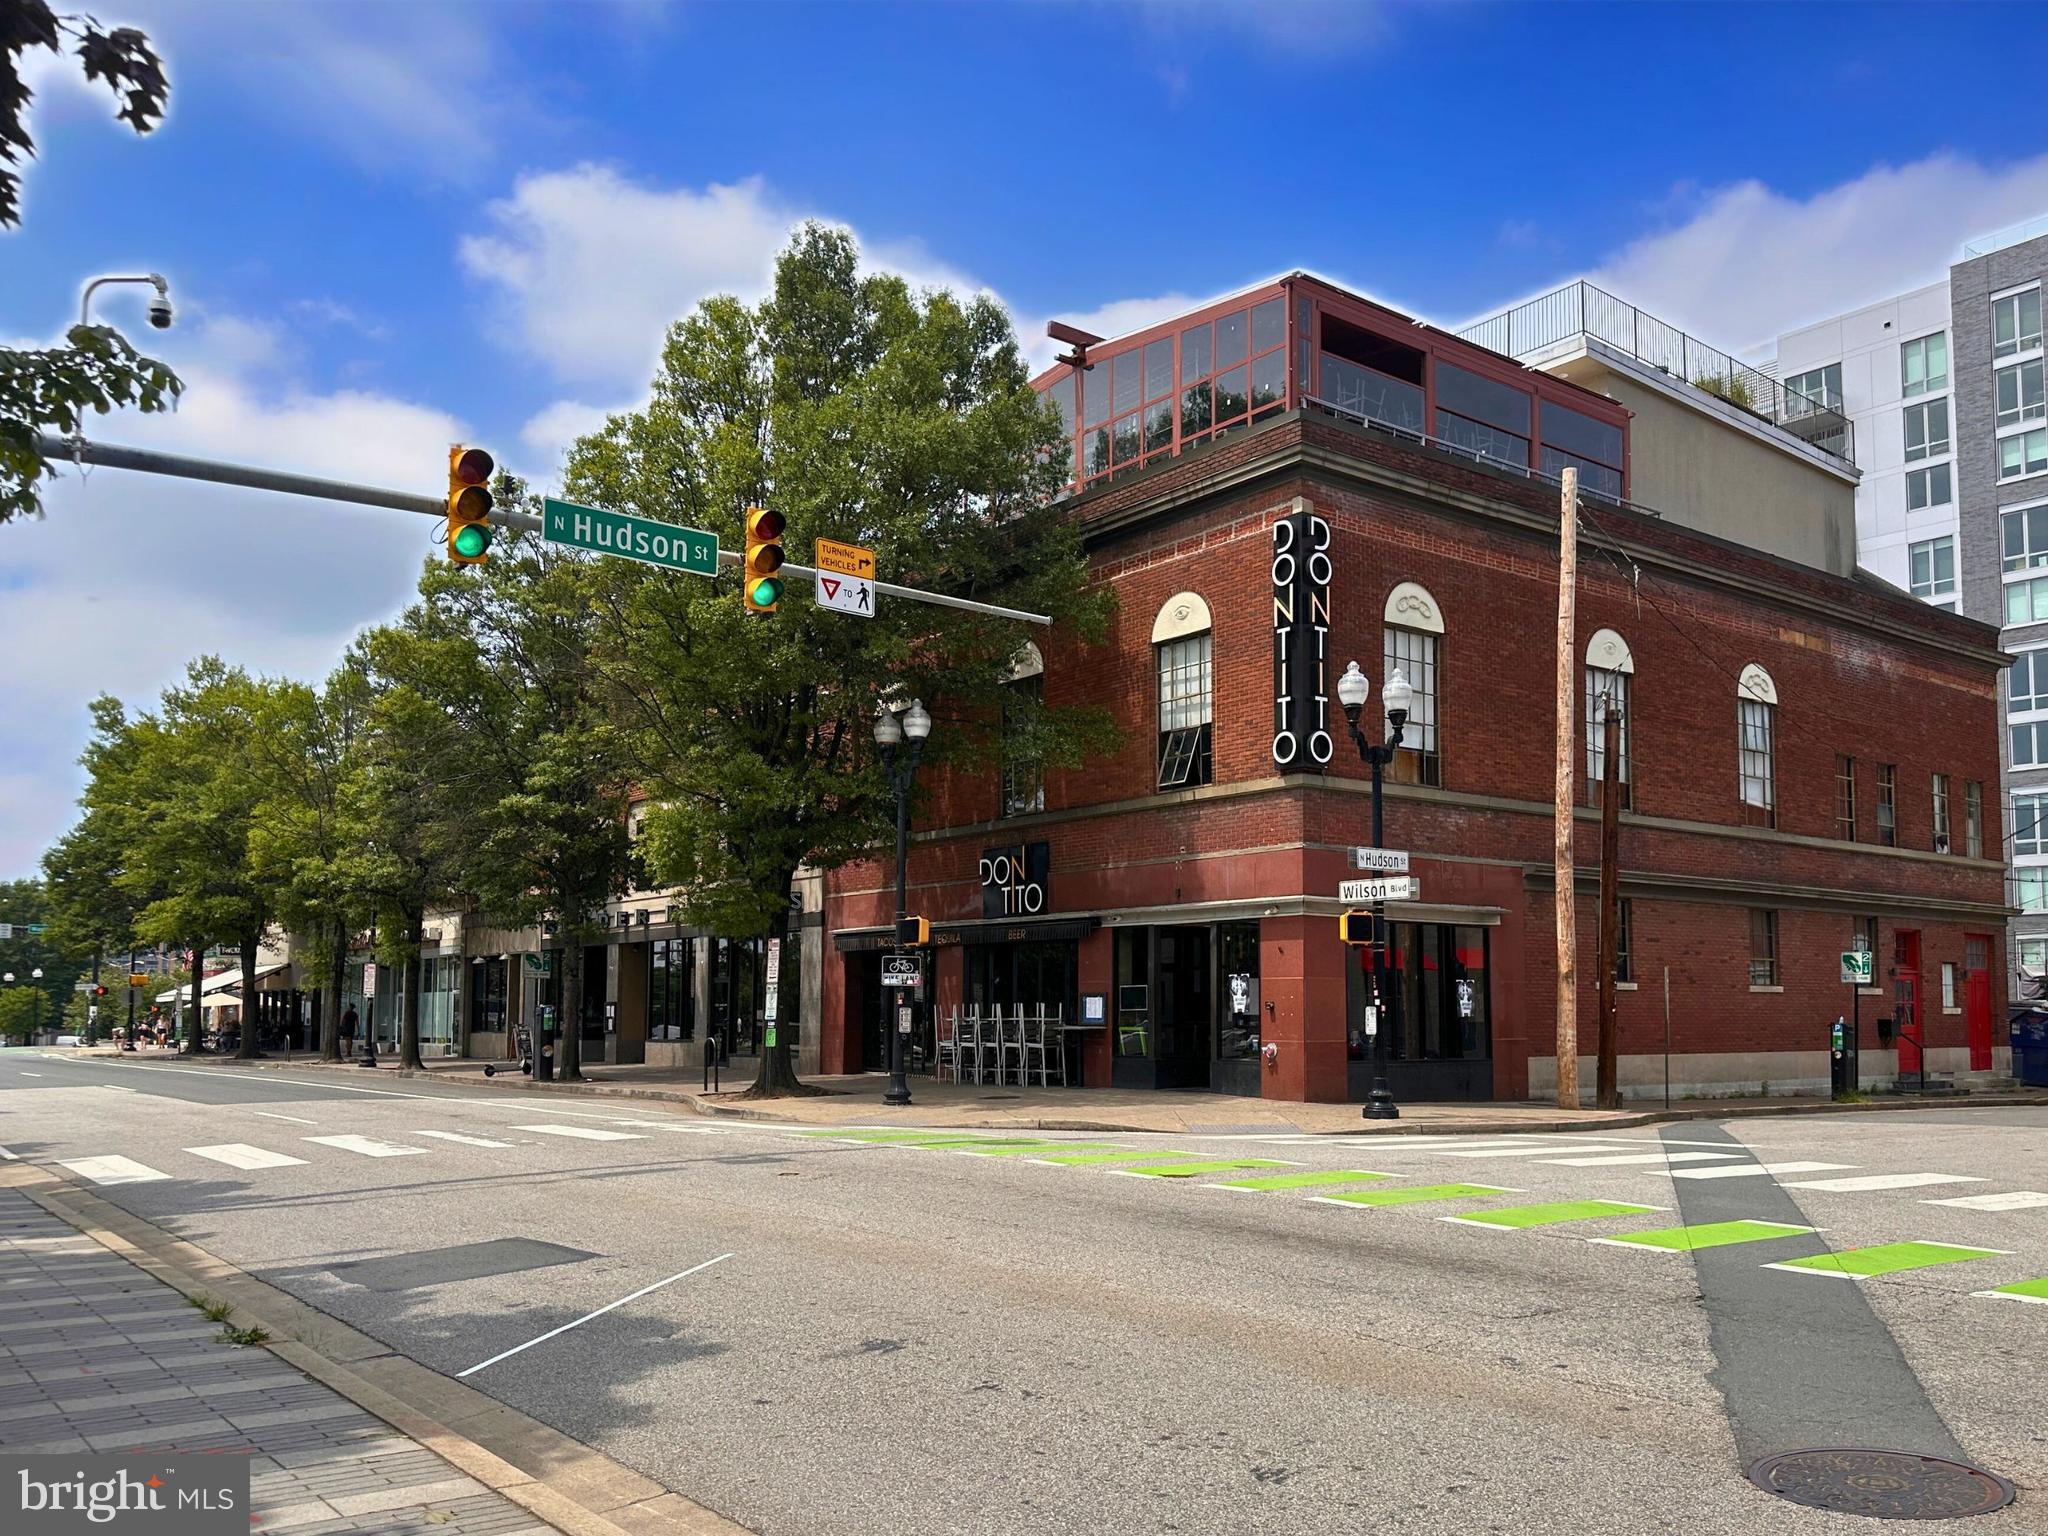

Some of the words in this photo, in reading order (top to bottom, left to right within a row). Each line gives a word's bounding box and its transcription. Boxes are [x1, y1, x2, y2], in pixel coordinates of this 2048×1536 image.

[554, 515, 565, 531] N
[574, 513, 688, 563] Hudson
[694, 545, 709, 561] St
[821, 544, 856, 559] TURNING
[821, 556, 857, 571] VEHICLES
[1272, 519, 1296, 627] DON
[1309, 515, 1333, 625] DON
[843, 588, 853, 598] TO
[1272, 627, 1297, 764] TITO
[1310, 626, 1334, 764] TITO
[979, 845, 1026, 886] DON
[1360, 854, 1365, 862] N
[1365, 852, 1399, 868] Hudson
[1001, 884, 1043, 914] TITO
[1343, 884, 1387, 899] Wilson
[1390, 884, 1407, 893] Blvd
[1008, 929, 1026, 940] BEER
